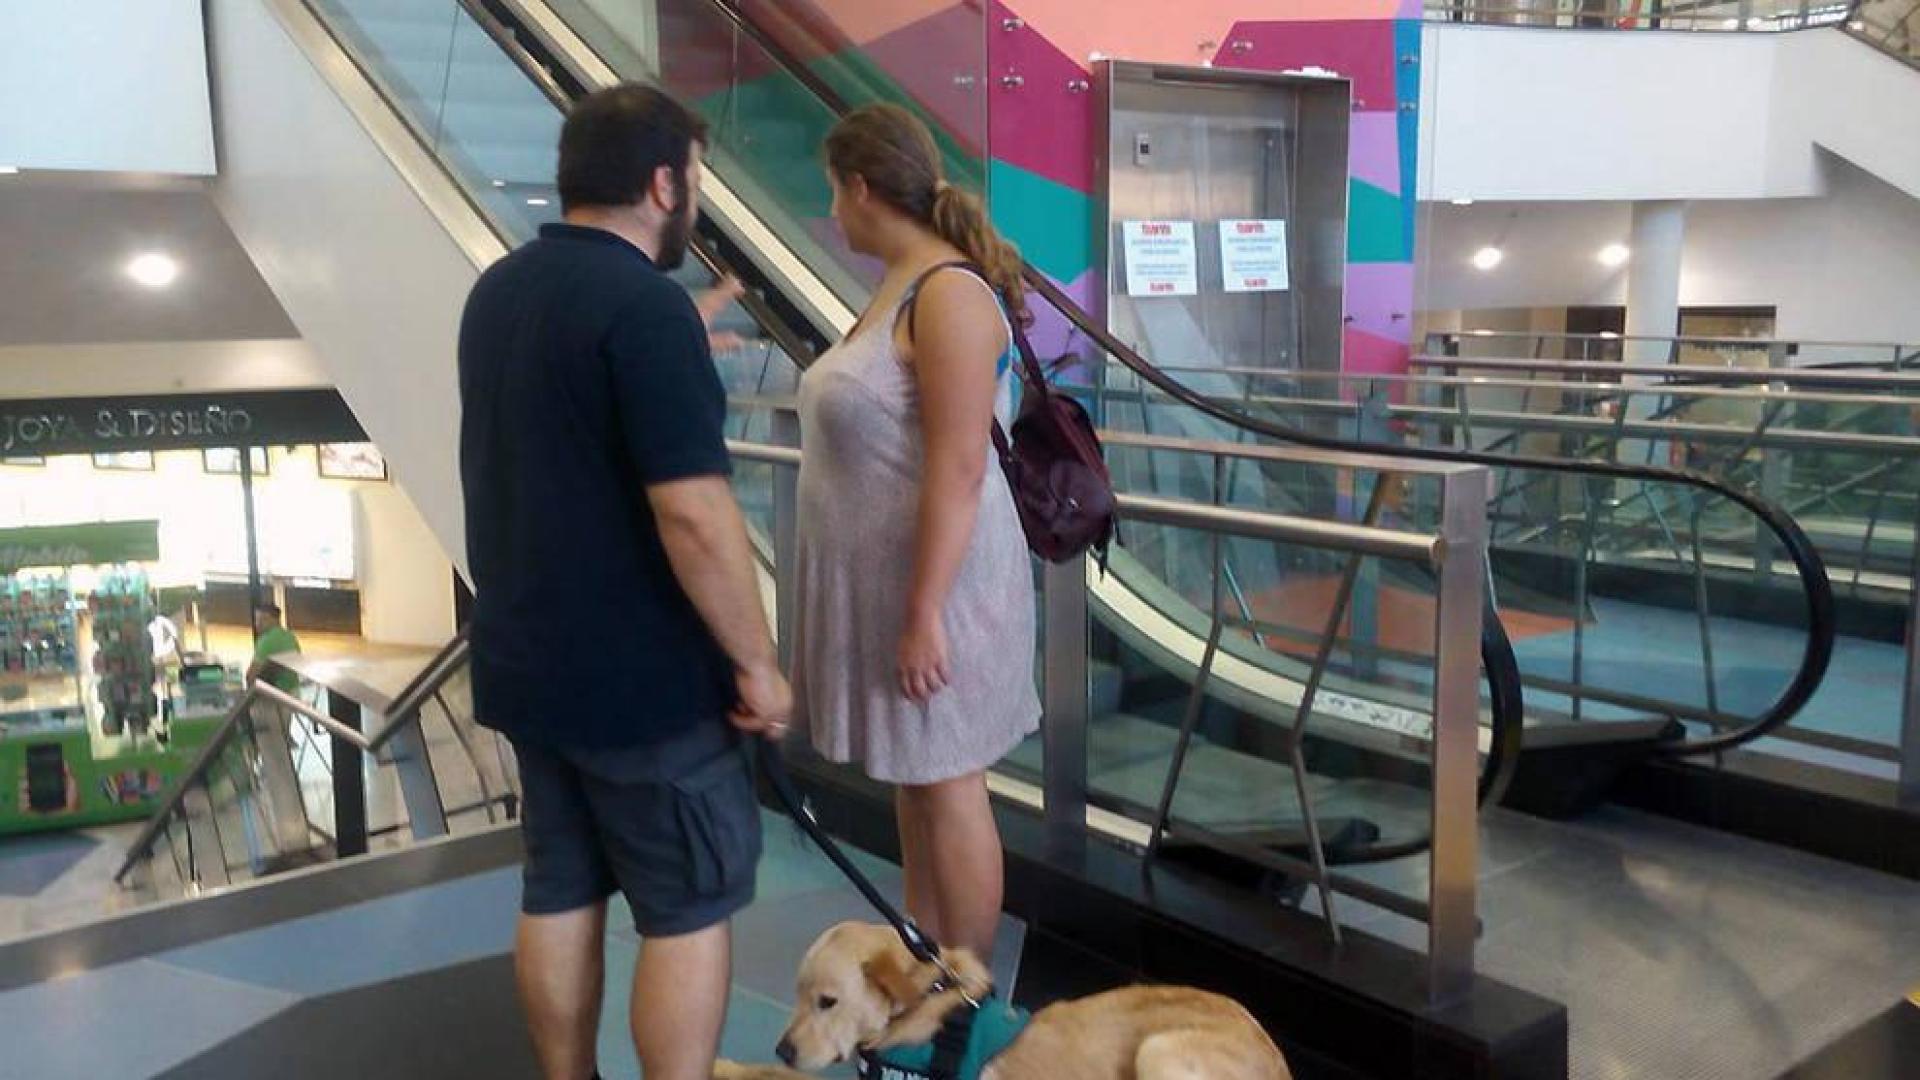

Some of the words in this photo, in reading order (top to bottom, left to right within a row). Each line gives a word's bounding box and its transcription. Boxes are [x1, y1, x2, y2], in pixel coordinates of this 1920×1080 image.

[4, 414, 87, 450] JOYA
[95, 408, 124, 437] &
[129, 405, 252, 437] DISEÑO
